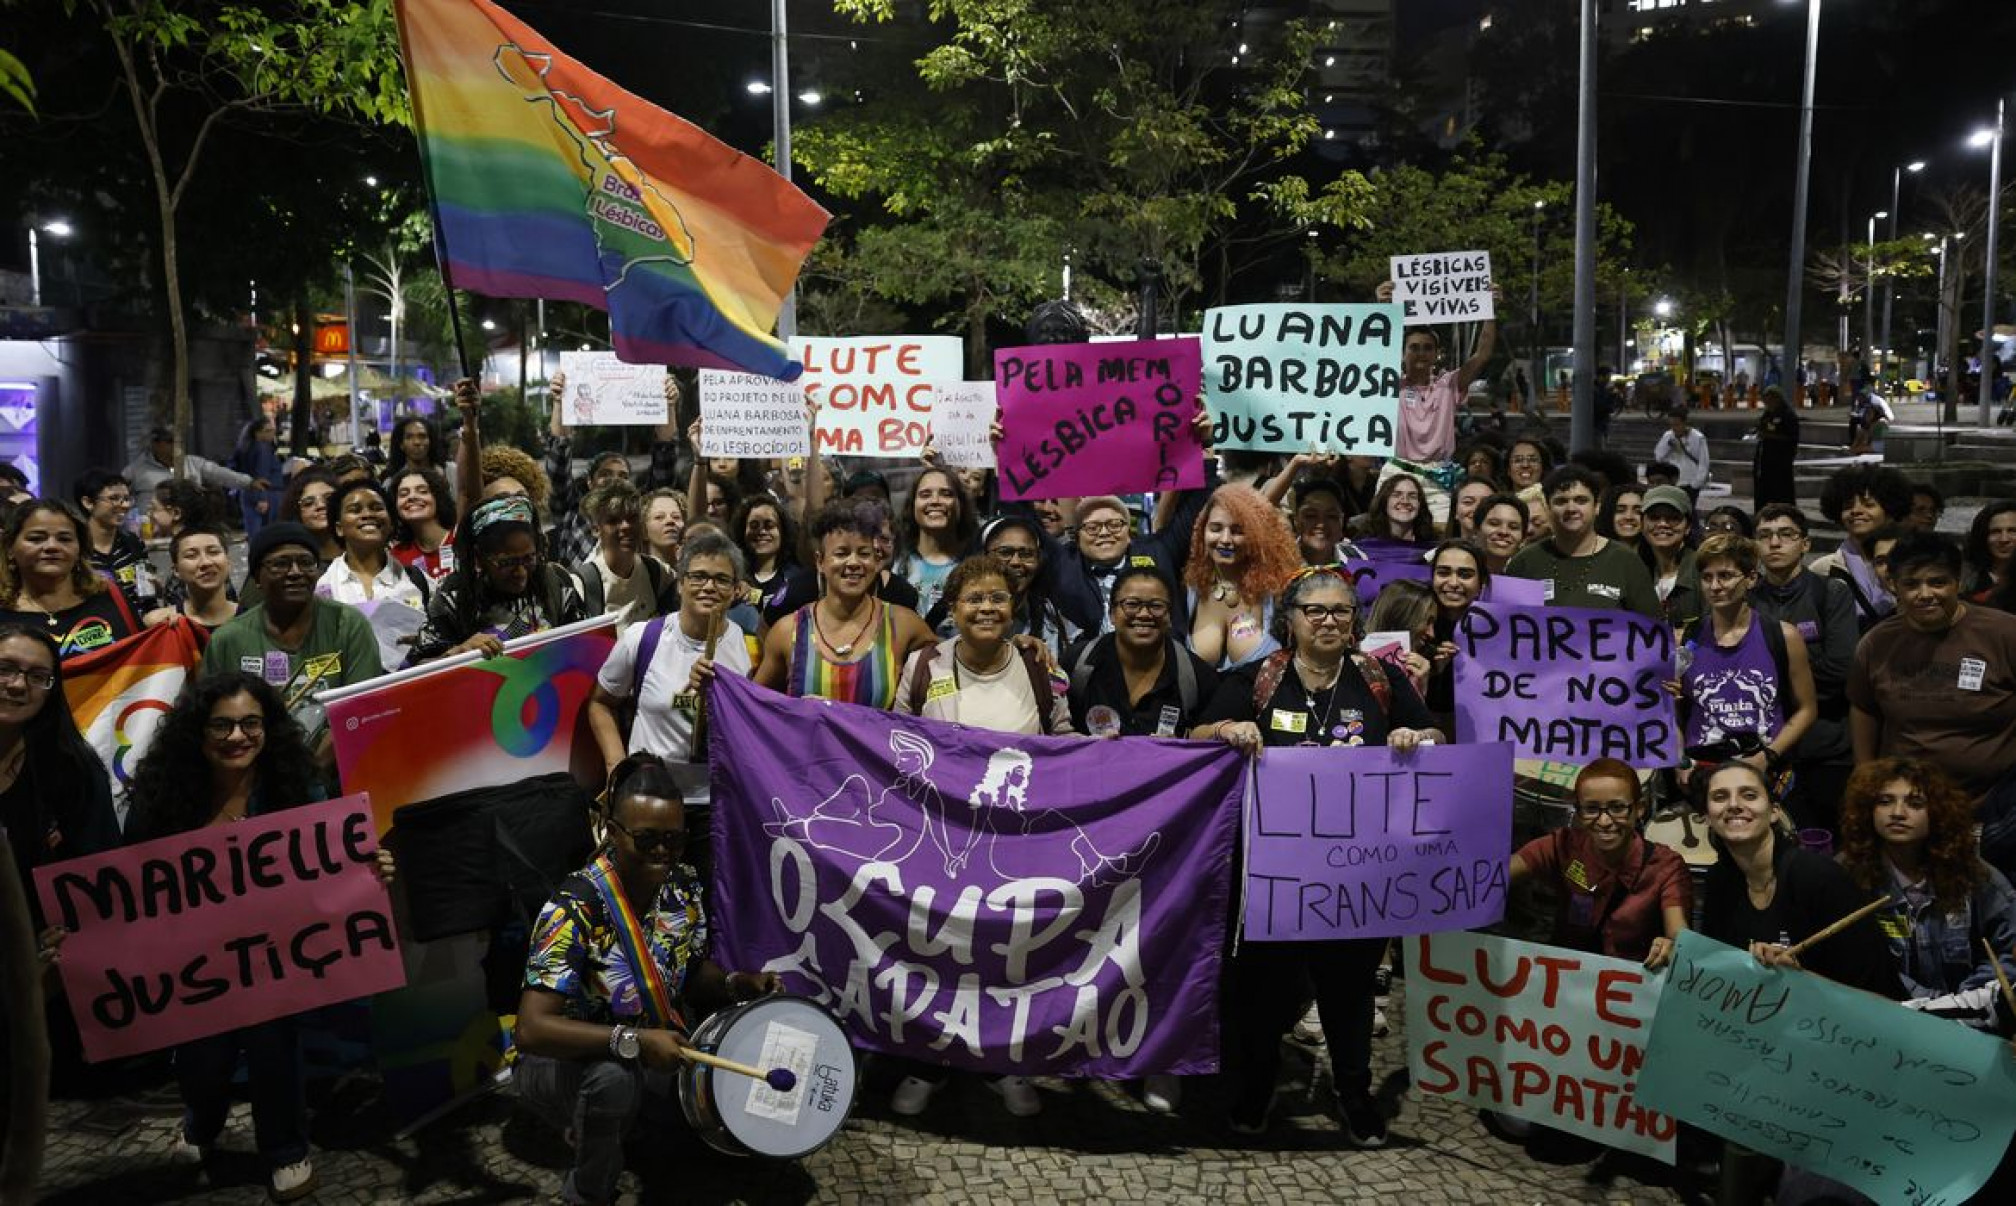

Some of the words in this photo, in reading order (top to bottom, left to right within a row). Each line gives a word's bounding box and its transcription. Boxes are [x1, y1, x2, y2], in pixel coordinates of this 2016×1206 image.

[1397, 256, 1486, 279] LÉSBICAS
[1404, 299, 1418, 317] E
[1425, 298, 1481, 317] VIVAS
[1212, 312, 1392, 347] LUANA
[803, 344, 923, 376] LUTE
[1001, 356, 1084, 392] PELA
[1216, 354, 1400, 399] BARBOSA
[703, 374, 725, 386] PELA
[719, 392, 768, 403] PROJETO
[771, 392, 785, 404] DE
[704, 409, 740, 420] LUANA
[743, 409, 801, 421] BARBOSA
[878, 417, 932, 451] BO
[1005, 396, 1136, 496] LÉSBICA
[1461, 606, 1670, 662] PAREM
[1482, 670, 1538, 699] DE
[1567, 671, 1664, 708] NOS
[1498, 716, 1670, 761] MATAR
[1252, 760, 1453, 839] LUTE
[52, 812, 378, 932] MARIELLE
[1326, 843, 1399, 868] COMO
[1415, 840, 1459, 857] UMA
[1248, 871, 1420, 935] TRANS
[1419, 935, 1644, 1029] LUTE
[1427, 995, 1572, 1057] COMO
